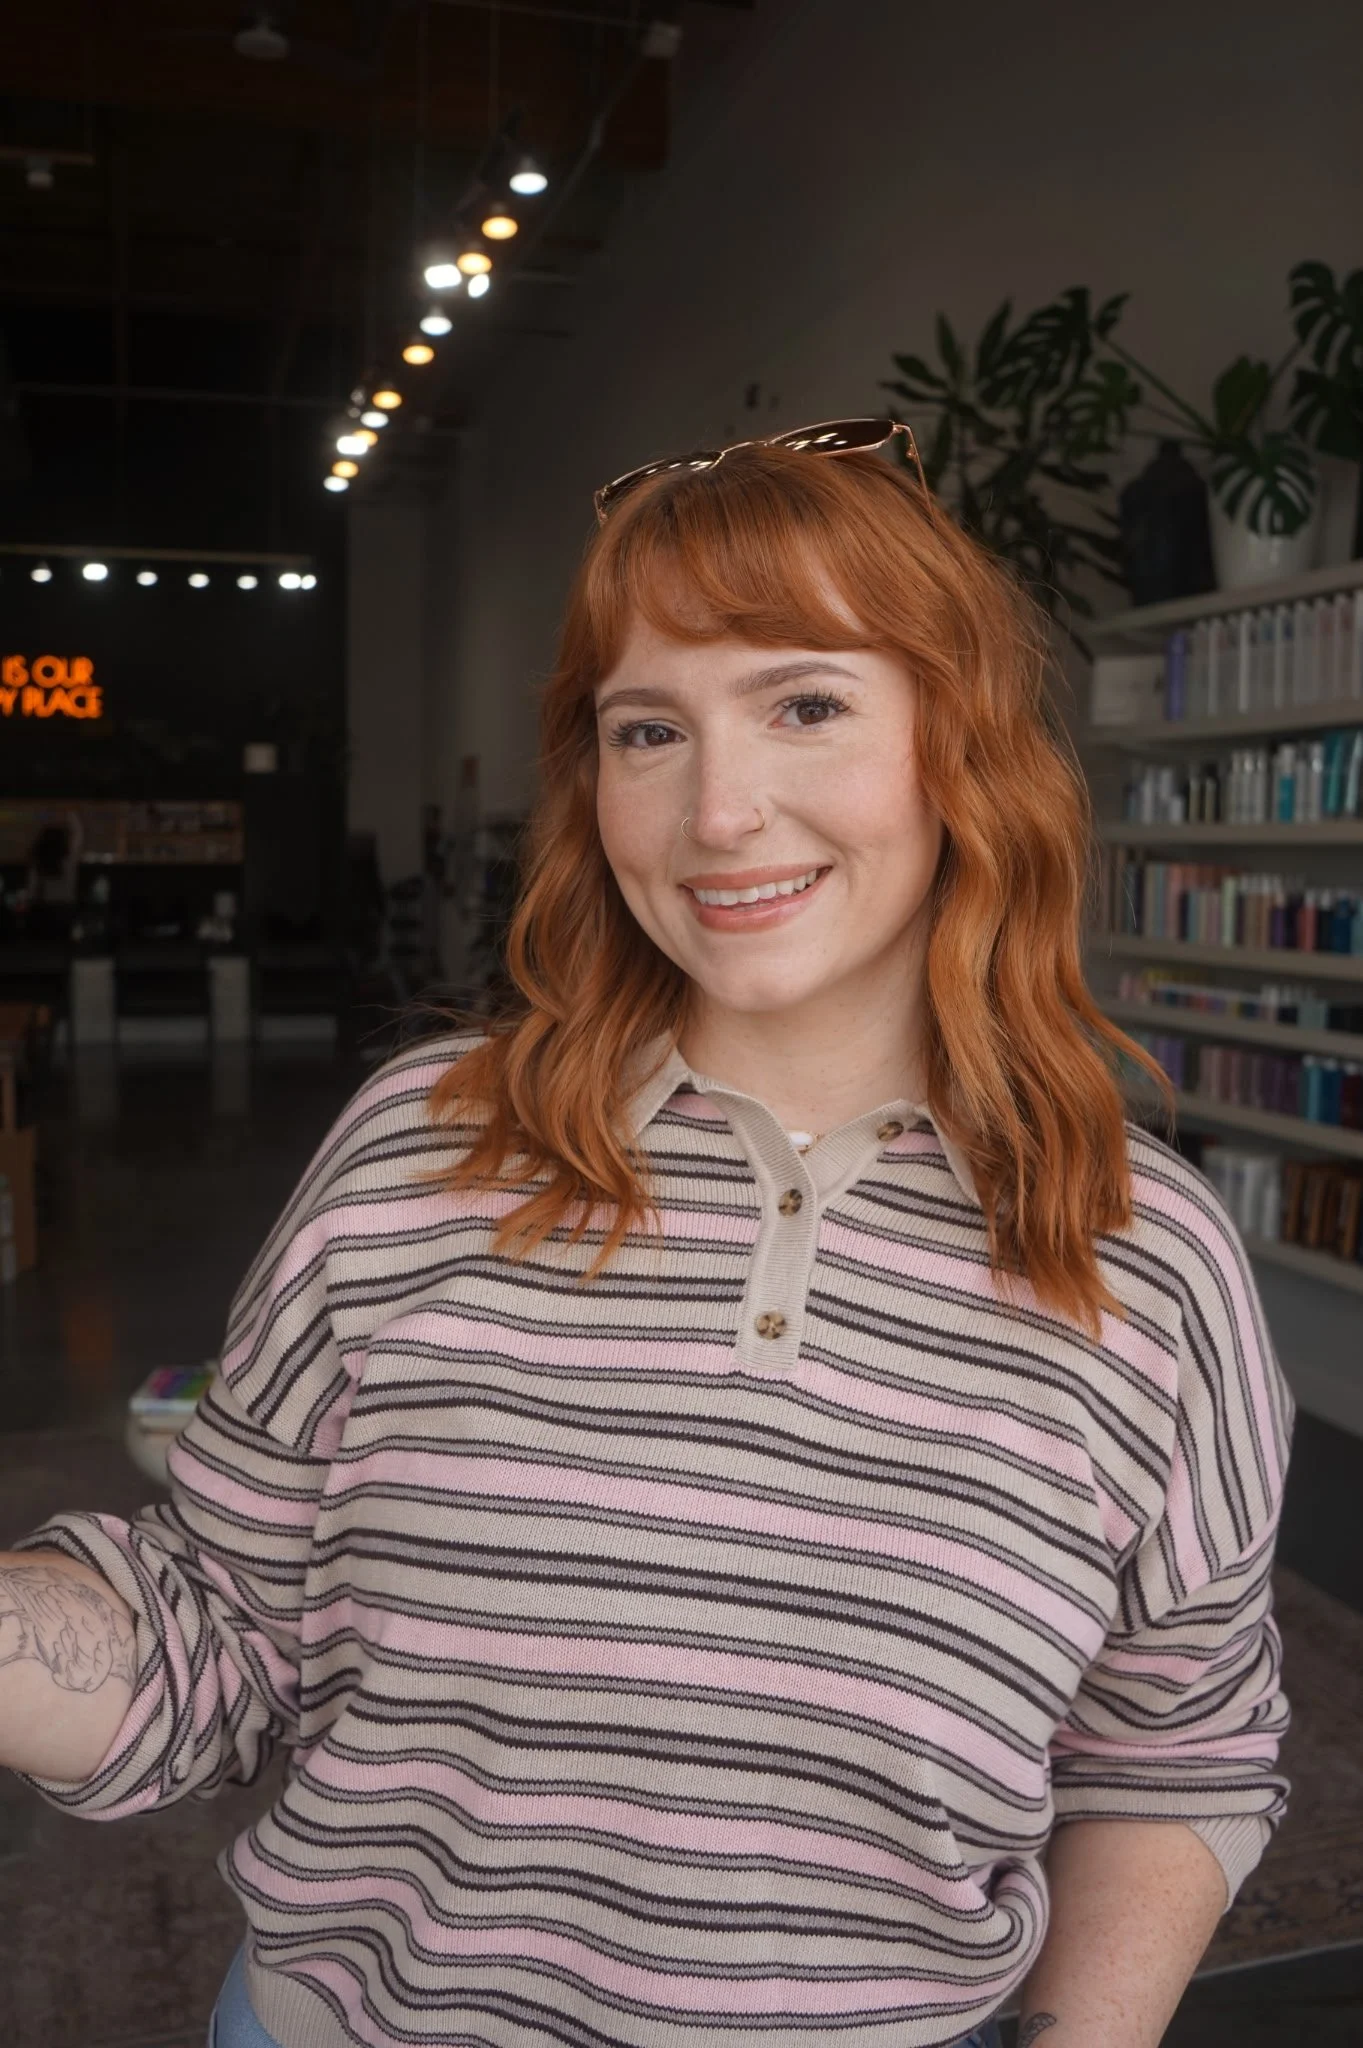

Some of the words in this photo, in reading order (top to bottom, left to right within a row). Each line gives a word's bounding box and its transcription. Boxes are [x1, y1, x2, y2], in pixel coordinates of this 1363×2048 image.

[2, 656, 29, 687] IS
[31, 656, 94, 688] OUR
[0, 686, 18, 717] Y
[21, 686, 103, 718] PLACE
